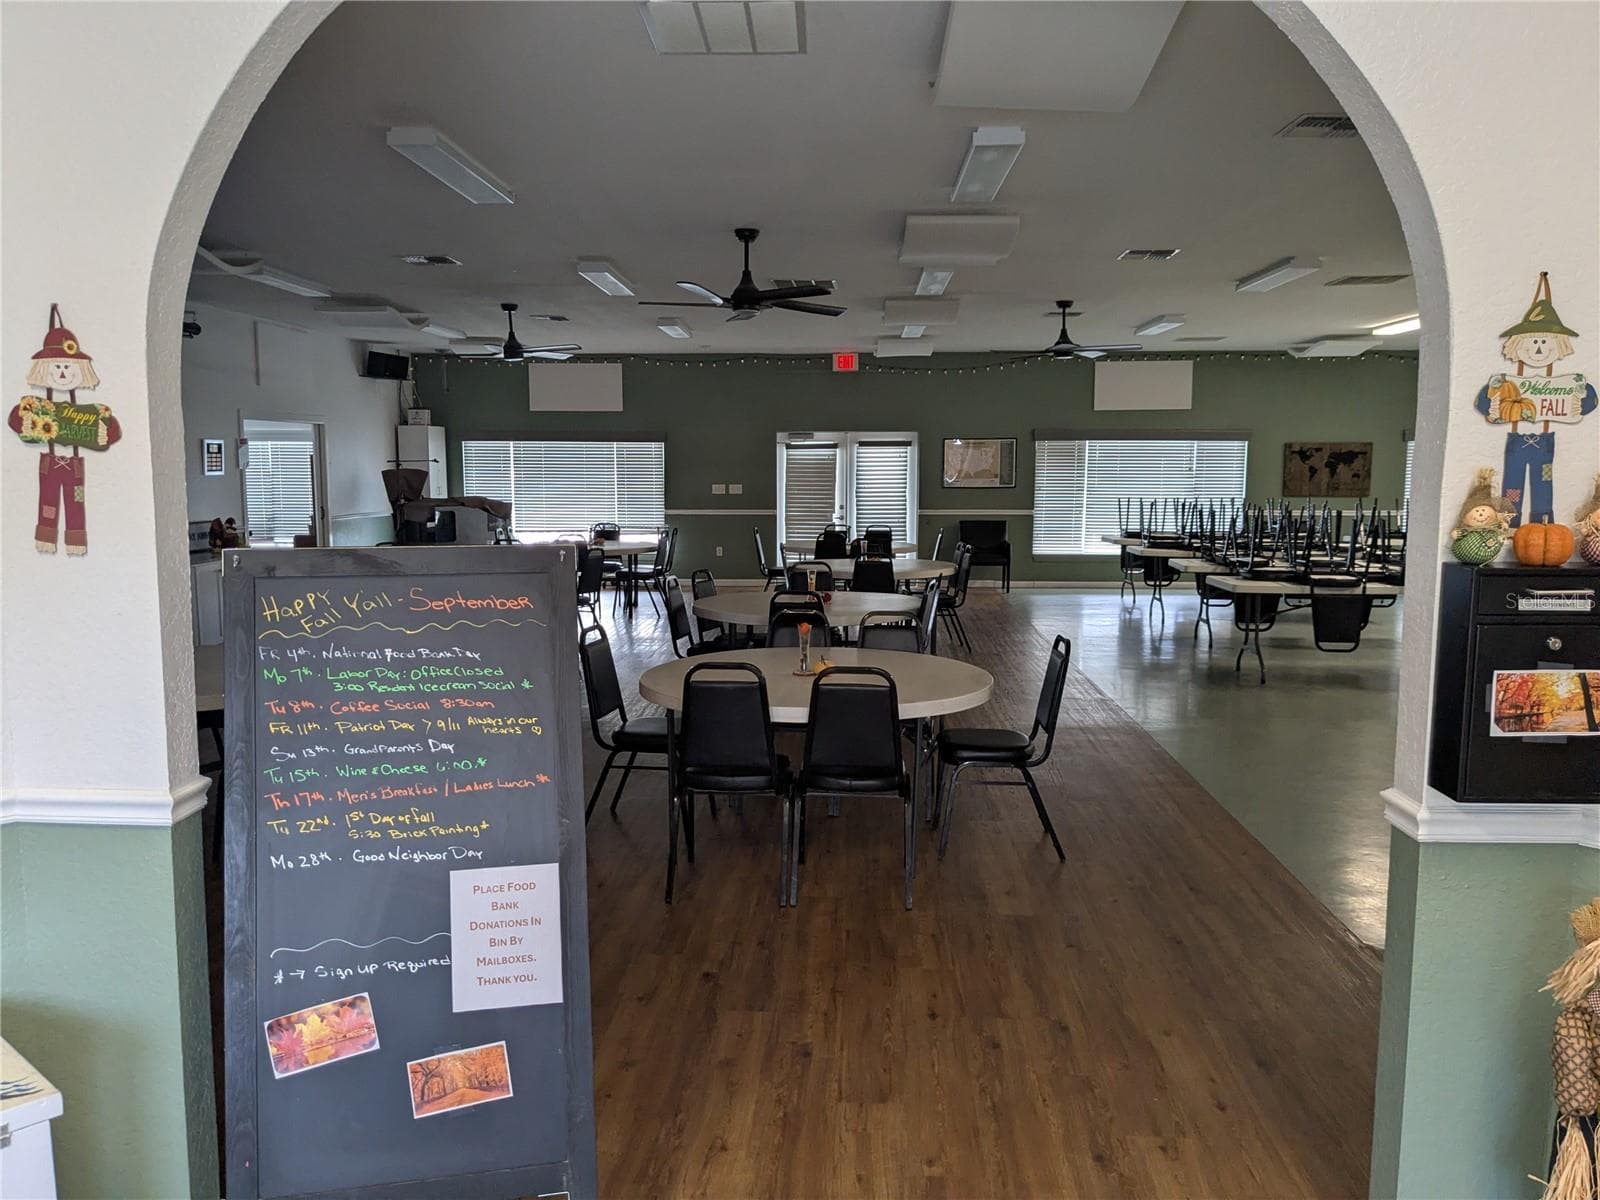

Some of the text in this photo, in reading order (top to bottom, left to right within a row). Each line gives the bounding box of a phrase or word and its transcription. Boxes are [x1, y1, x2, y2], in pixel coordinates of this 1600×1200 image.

[62, 404, 97, 424] Happy
[1540, 399, 1568, 416] FALL
[300, 608, 342, 633] Fall
[410, 665, 453, 680] Office
[454, 666, 505, 677] Closed
[333, 682, 365, 692] 3:00
[264, 700, 287, 714] Tu
[330, 700, 380, 715] Coffee
[384, 699, 431, 712] Social
[334, 720, 387, 734] Patriot
[387, 720, 415, 731] Day
[437, 717, 461, 731] 9/11
[467, 716, 503, 726] Always
[504, 716, 516, 725] in
[518, 717, 539, 725] our
[483, 725, 522, 734] hearts
[270, 746, 297, 761] Su
[428, 738, 456, 753] Day
[263, 767, 283, 784] Tu
[336, 764, 368, 777] Wine
[380, 764, 429, 775] Cheese
[336, 788, 377, 805] Men's
[378, 782, 438, 799] Breakfast
[454, 781, 494, 793] Ladies
[497, 779, 536, 788] Lunch
[267, 820, 290, 835] Tu
[368, 812, 396, 826] Day
[348, 829, 381, 839] 5:30
[387, 829, 428, 839] Brick
[270, 854, 294, 869] Mo
[352, 849, 385, 863] Good
[388, 845, 448, 863] Neighbor
[448, 846, 484, 860] Day
[473, 882, 536, 895] PLACE FOOD
[491, 901, 519, 911] BANK
[469, 917, 542, 931] DONATIONS IN
[489, 936, 524, 948] BIN BY
[314, 965, 354, 979] Sign
[382, 955, 453, 973] Required
[476, 954, 537, 967] MAILBOXES.
[477, 975, 512, 986] THANK
